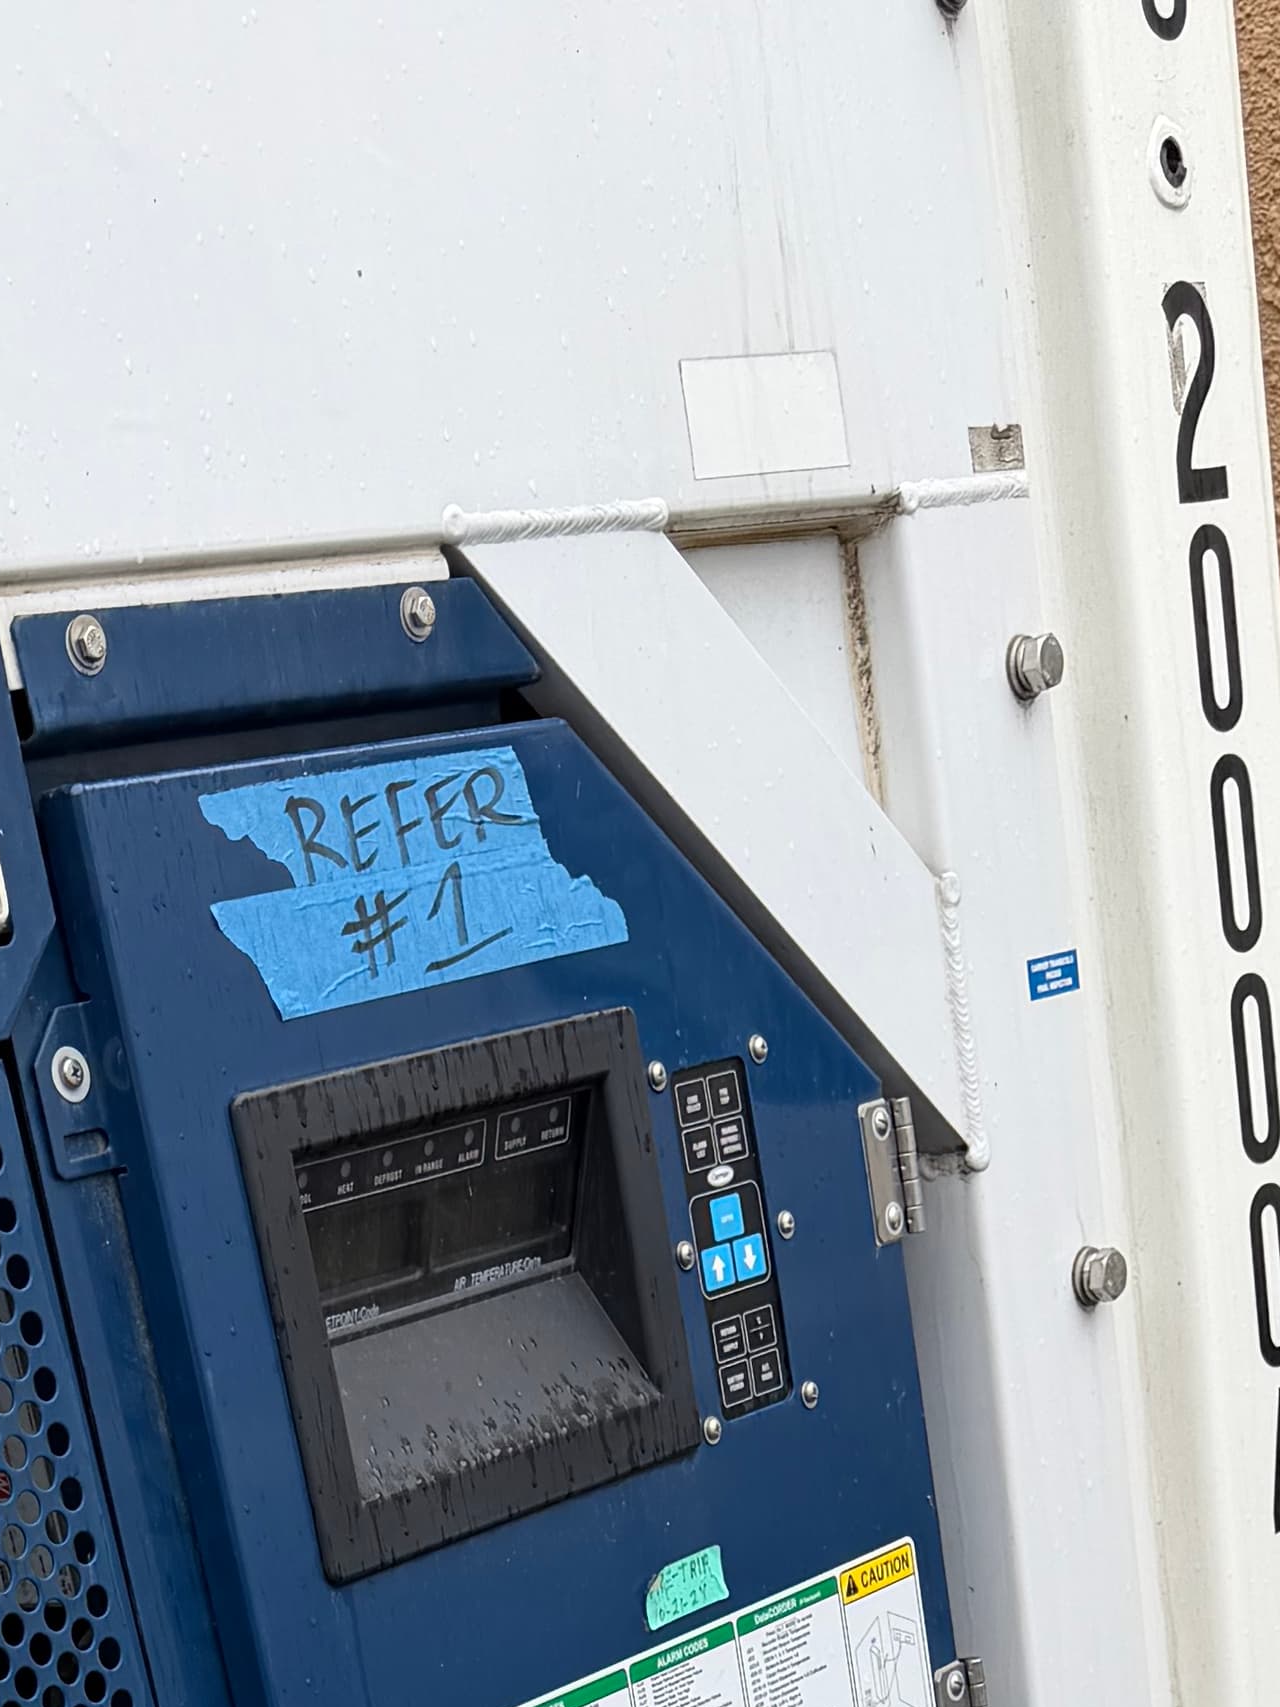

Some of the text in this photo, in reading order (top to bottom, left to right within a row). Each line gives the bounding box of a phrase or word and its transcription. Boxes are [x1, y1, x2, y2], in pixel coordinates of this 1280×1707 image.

[285, 766, 523, 884] REFER
[340, 861, 513, 979] #1
[541, 1126, 564, 1140] RETURN
[504, 1136, 527, 1151] SUPPLY
[458, 1149, 480, 1163] ALARM
[374, 1170, 403, 1186] DEFROST
[337, 1182, 354, 1195] HEAT
[860, 1551, 909, 1588] CAUTION
[656, 1637, 708, 1668] ALARM CODES
